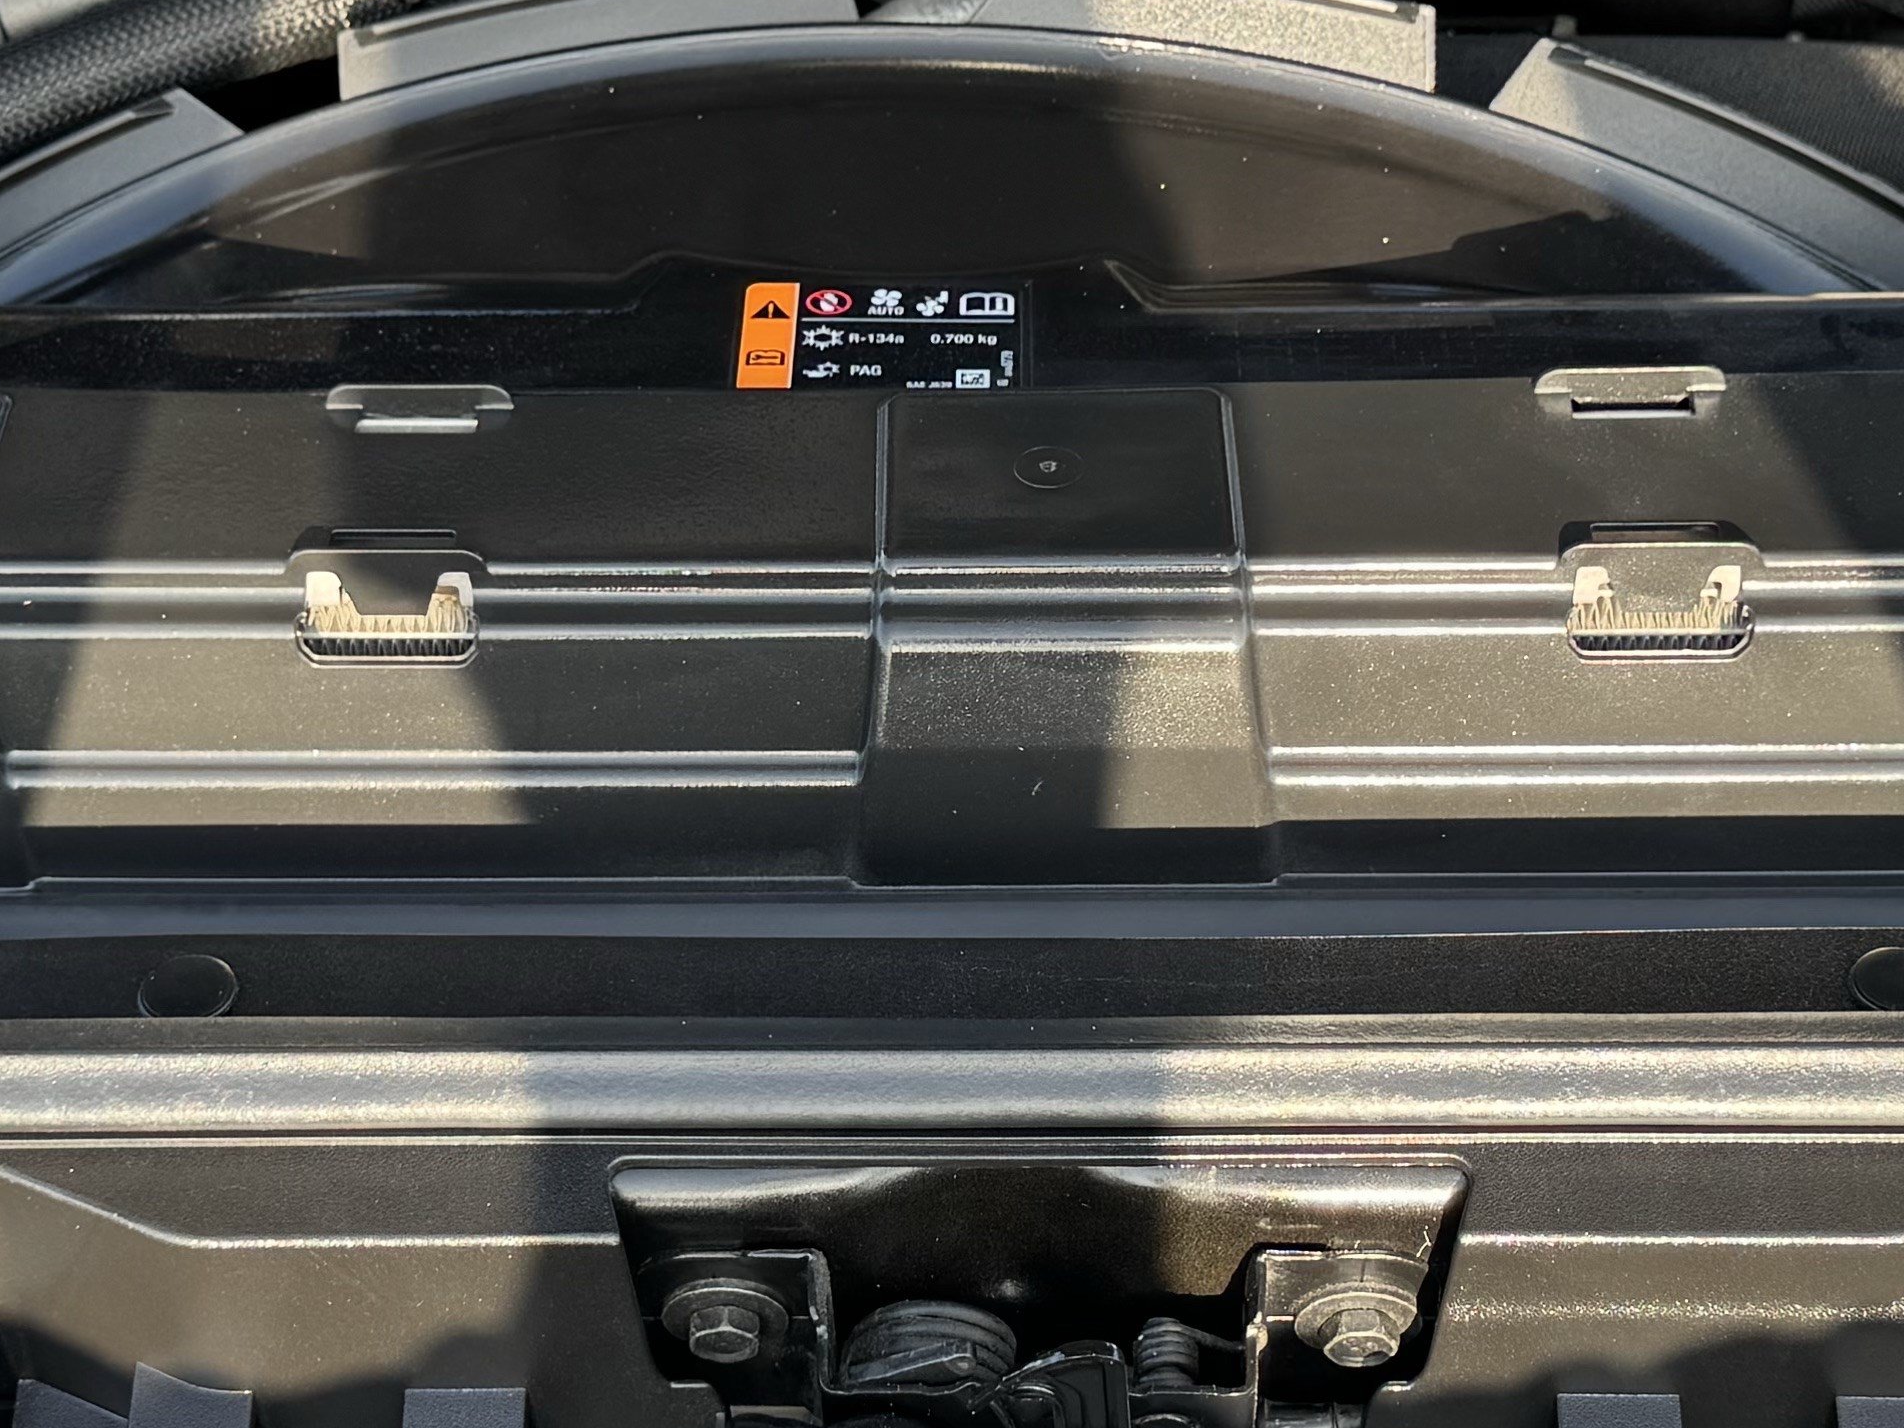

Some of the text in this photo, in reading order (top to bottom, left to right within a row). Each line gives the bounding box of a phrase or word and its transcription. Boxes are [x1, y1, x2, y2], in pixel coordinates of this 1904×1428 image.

[867, 305, 905, 316] AUTO
[848, 333, 998, 346] R-134a 0.700 kg
[849, 364, 883, 377] PAG
